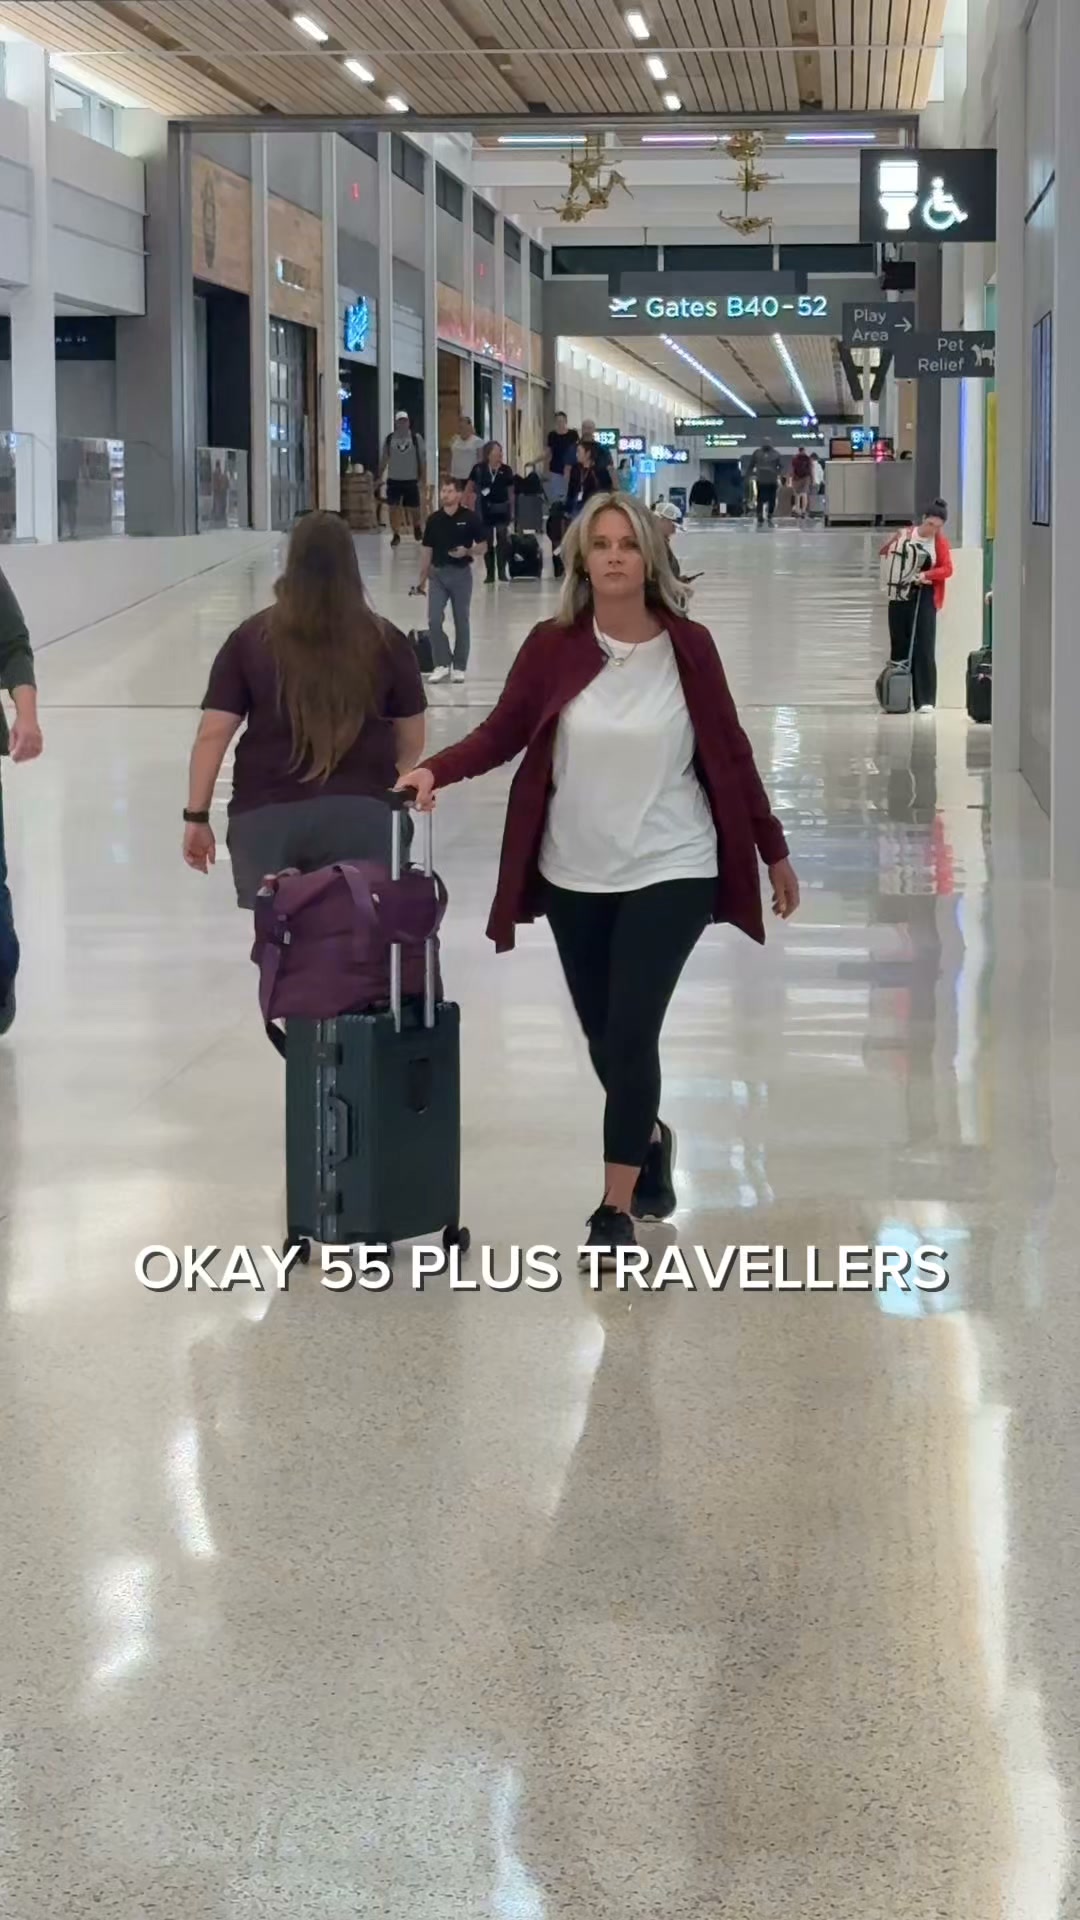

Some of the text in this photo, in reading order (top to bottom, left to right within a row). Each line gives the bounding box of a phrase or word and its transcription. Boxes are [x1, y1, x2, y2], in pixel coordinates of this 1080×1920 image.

[645, 296, 828, 318] Gates B40-52
[853, 308, 887, 325] Play
[851, 329, 889, 342] Area
[937, 338, 965, 352] Pet
[918, 358, 965, 372] Relief
